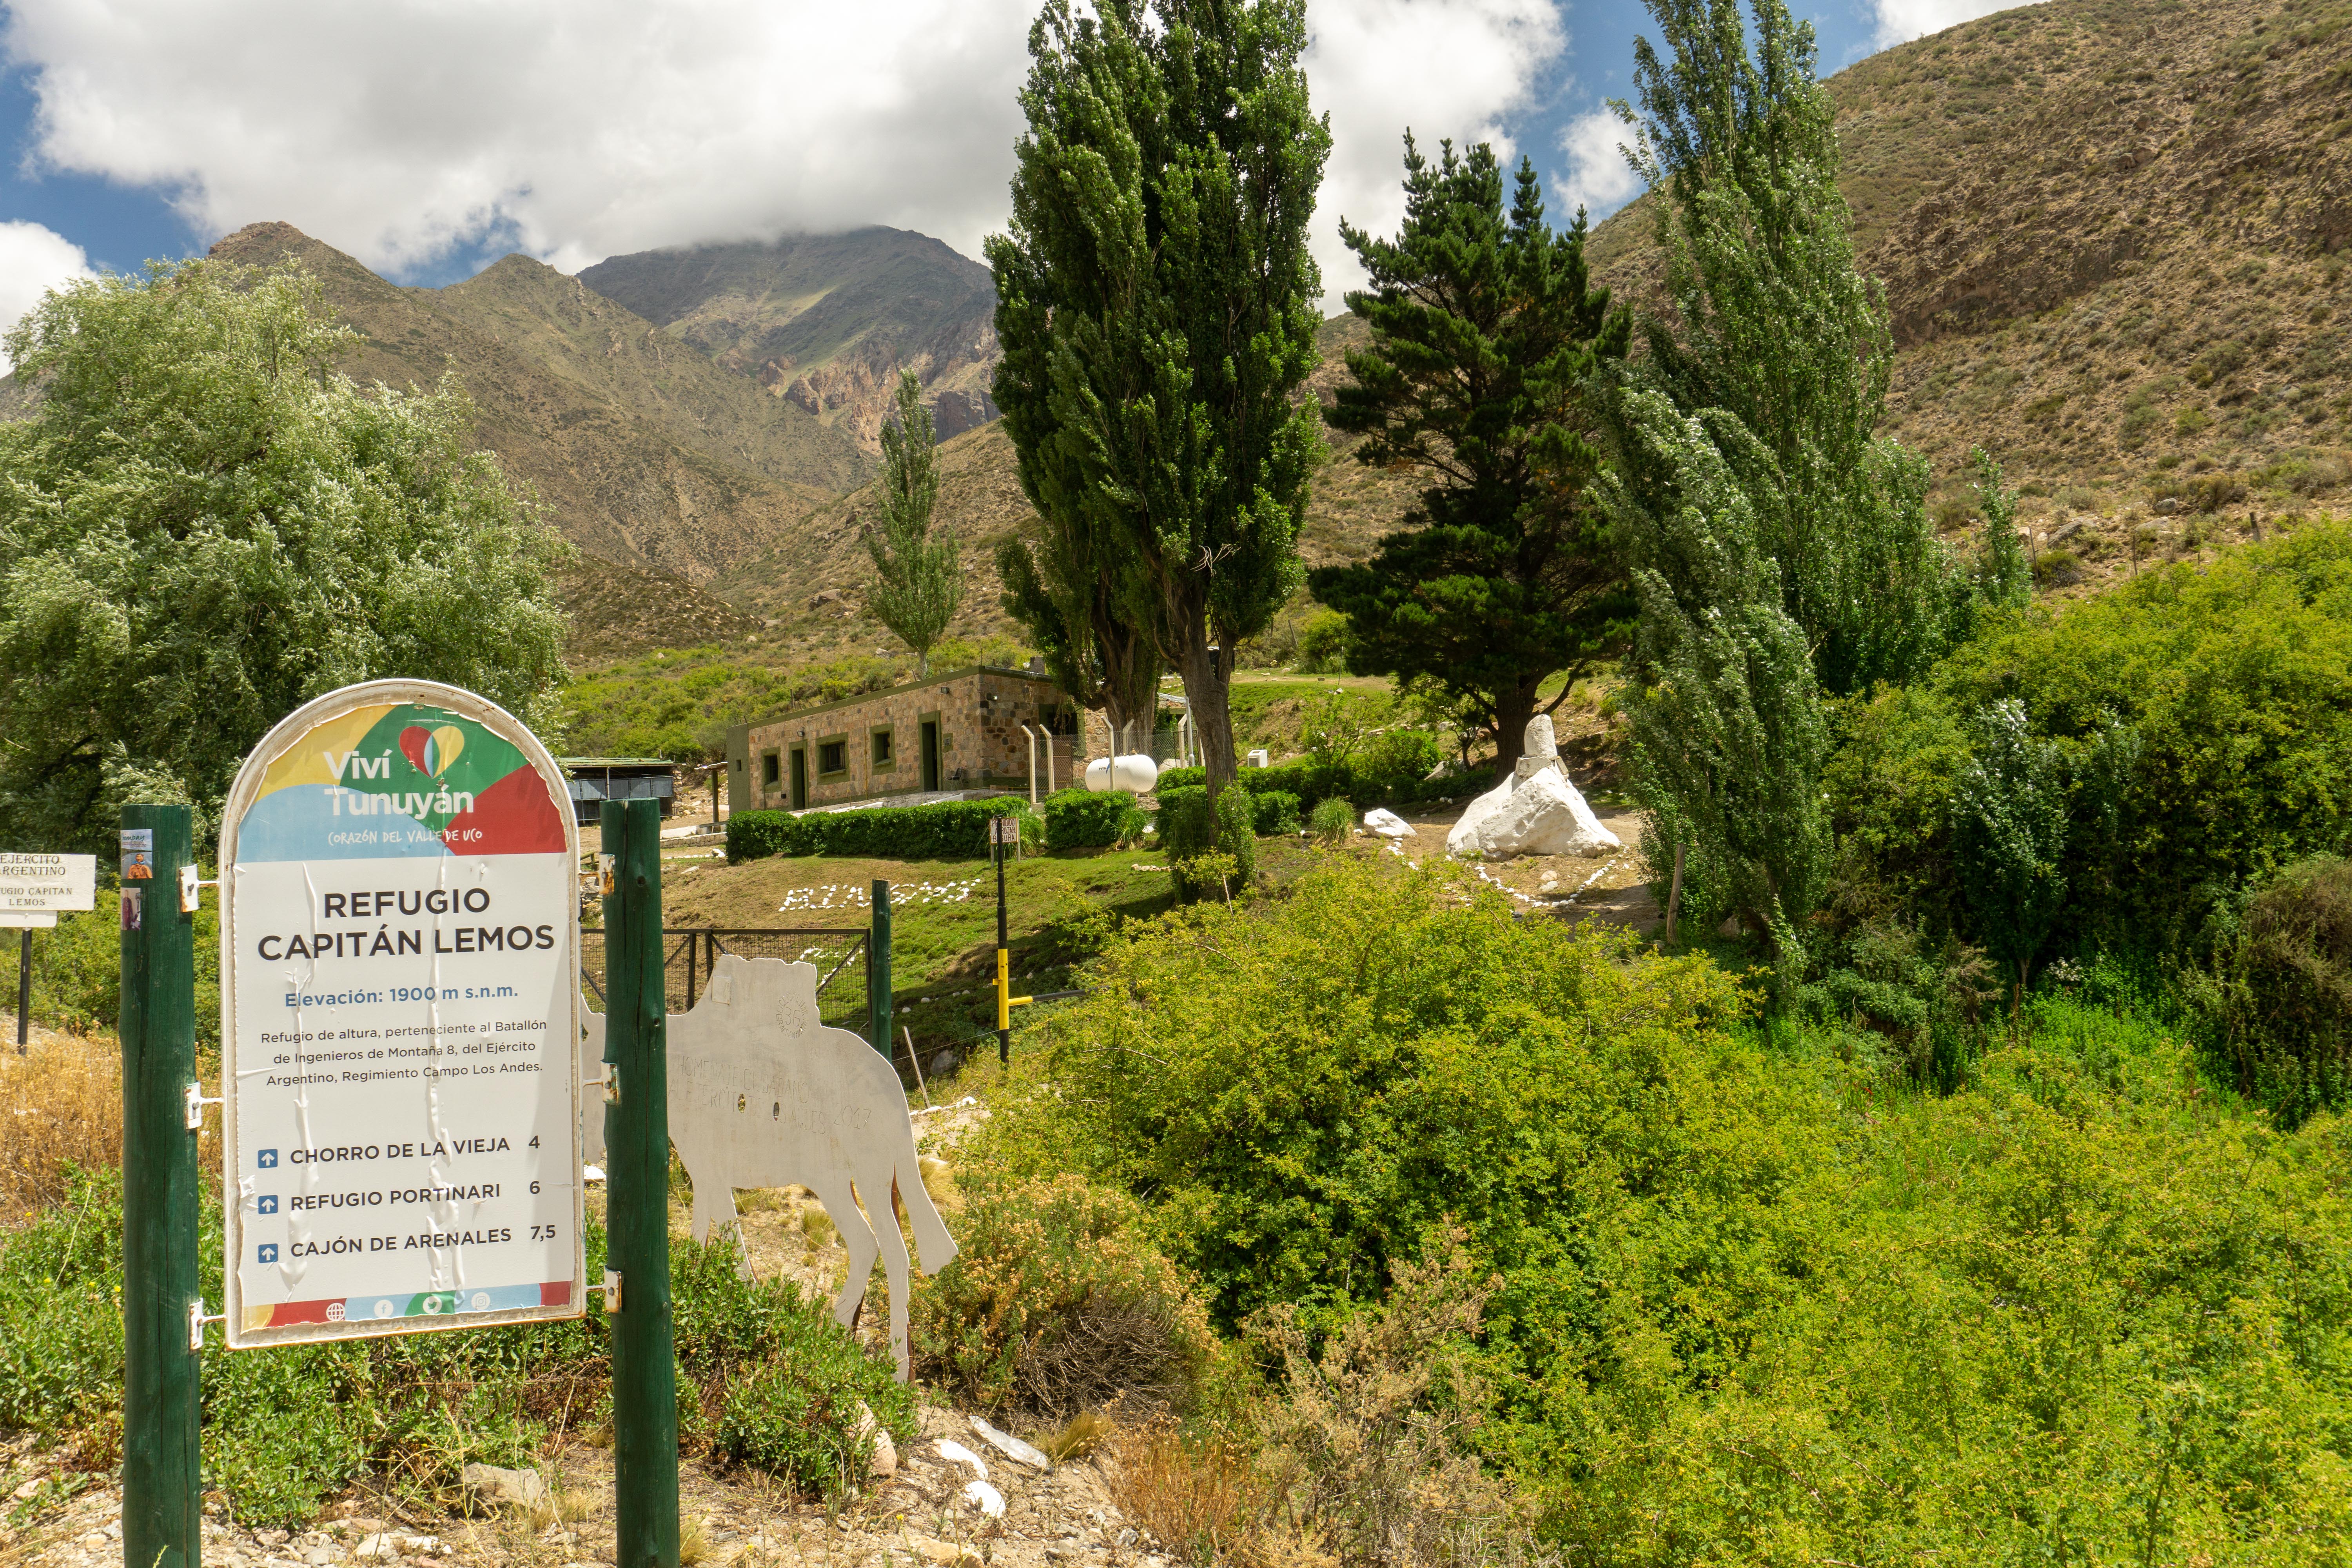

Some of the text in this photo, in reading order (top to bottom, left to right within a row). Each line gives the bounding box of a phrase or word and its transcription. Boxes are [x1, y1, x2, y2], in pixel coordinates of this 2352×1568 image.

[324, 748, 393, 779] Viví
[325, 785, 474, 820] Tunuyán
[992, 818, 1014, 828] PRHIBIDO
[995, 826, 1016, 835] AROJAR
[328, 829, 483, 846] CORAZÓN DEL VALLE DE UCO
[0, 855, 60, 864] EJERCITO
[0, 866, 66, 875] RGENTINO
[28, 887, 73, 896] CAPITAN
[325, 888, 490, 918] REFUGIO
[258, 924, 554, 960] CAPITÁN LEMOS
[286, 985, 518, 1007] Elevación: 1900 m s.n.m.
[785, 1007, 800, 1027] 36
[261, 1019, 546, 1044] Refugio de altura, perteneciente al Batallón
[274, 1041, 535, 1065] de Ingenieros de Montaña 8, del Ejército
[267, 1062, 543, 1087] Argentino, Regimiento Campo Los Andes.
[678, 1054, 739, 1087] HOMENAJE
[833, 1104, 871, 1129] 2017
[290, 1136, 540, 1164] CHORRO DE LA VIEJA 4
[291, 1181, 540, 1211] REFUGIO PORTINARI 6
[291, 1225, 556, 1257] CAJÓN DE ARENALES 7,5
